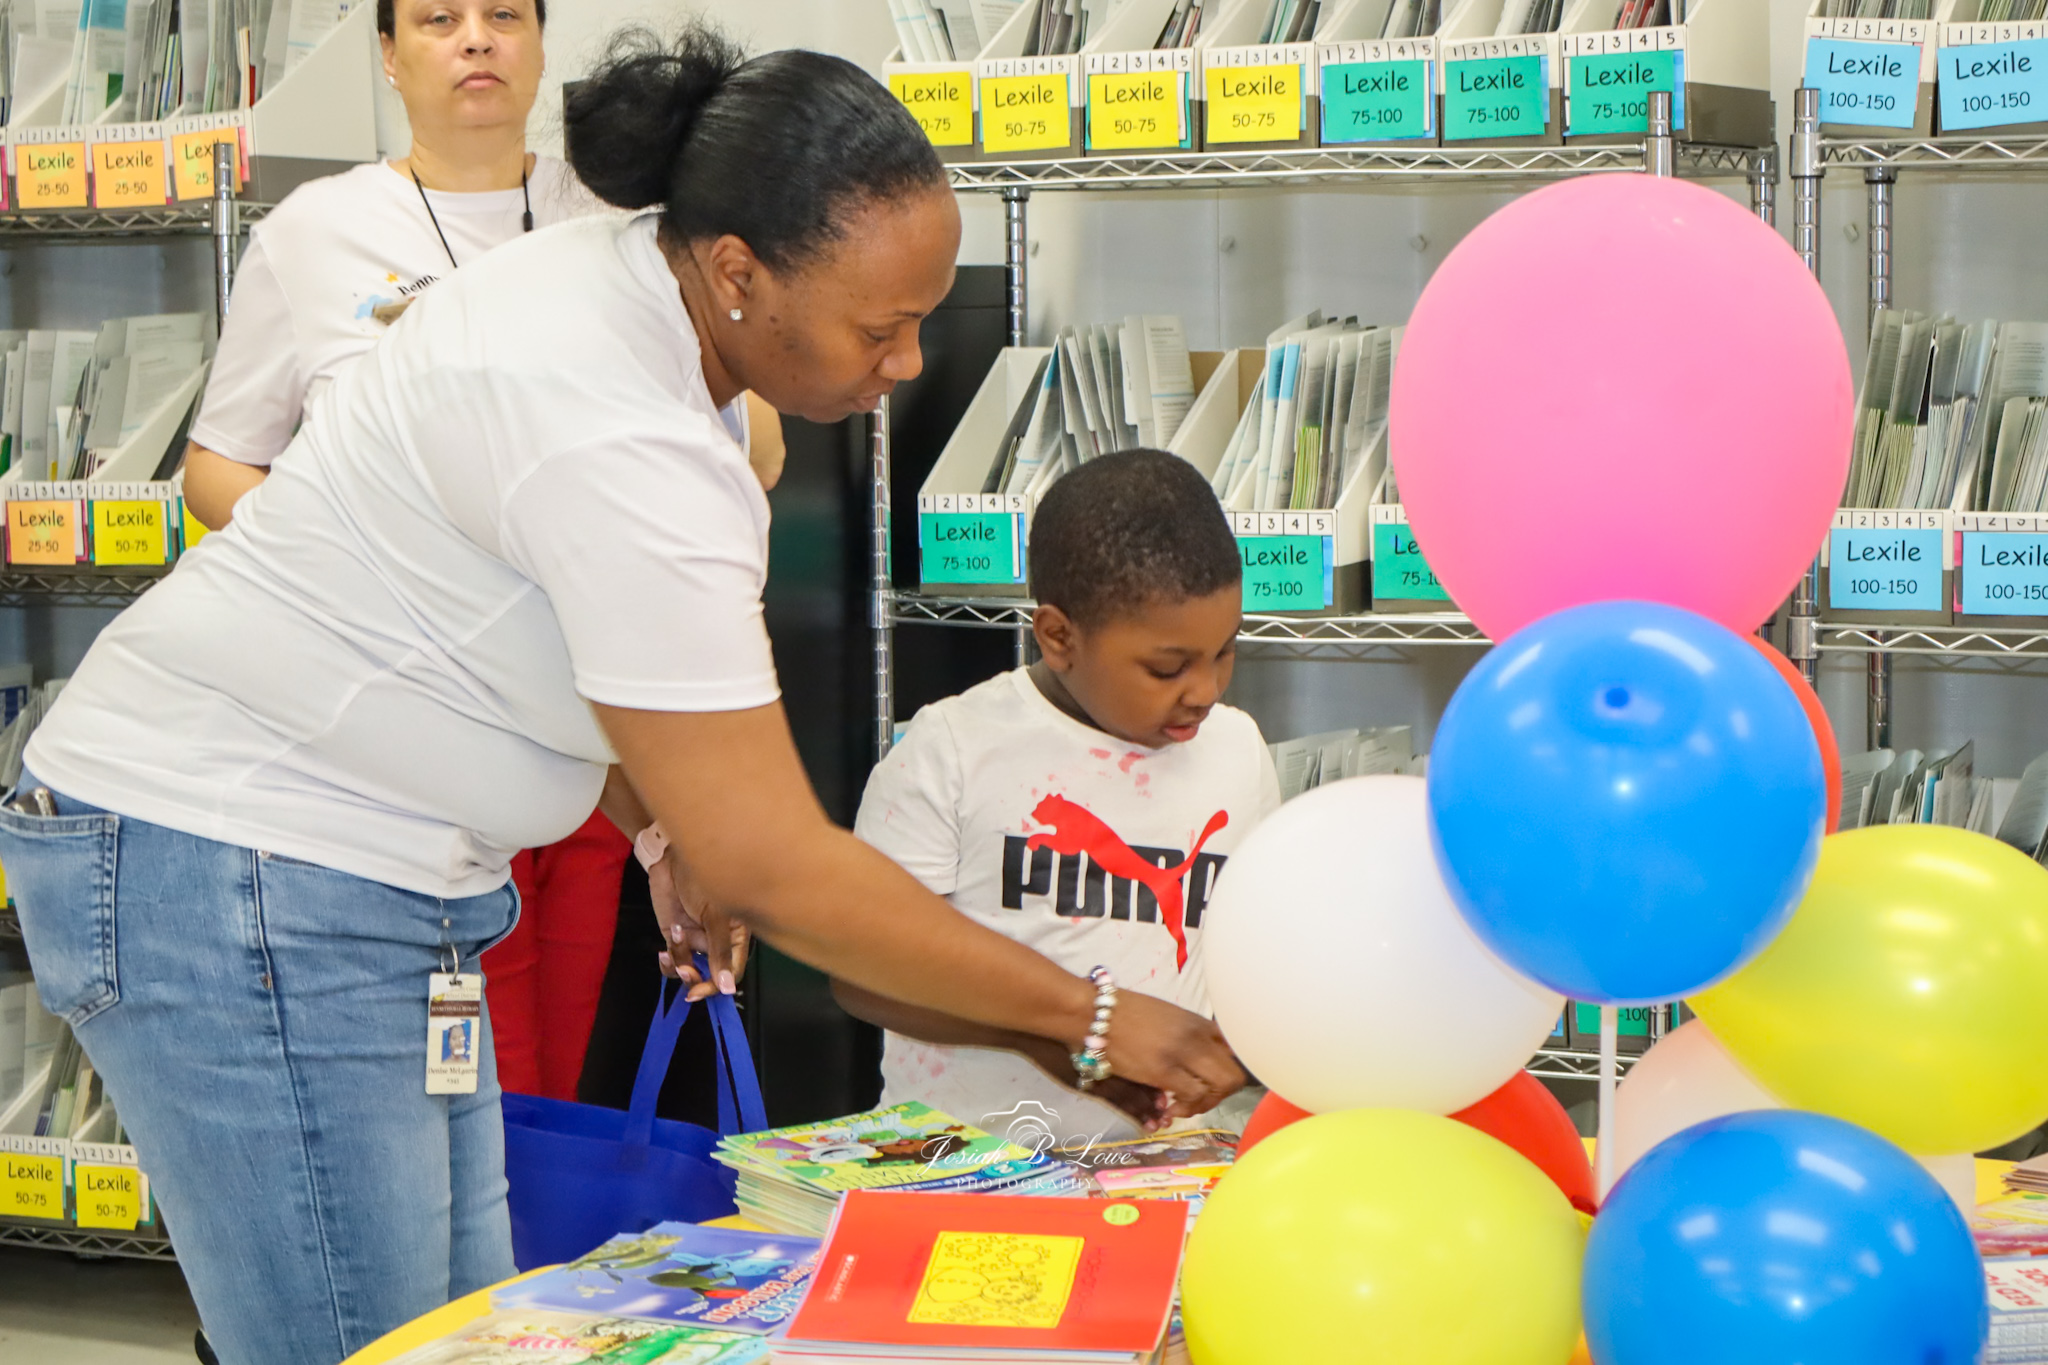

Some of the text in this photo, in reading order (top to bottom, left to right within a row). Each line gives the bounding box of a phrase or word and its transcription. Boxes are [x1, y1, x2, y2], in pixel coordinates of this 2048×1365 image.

[1842, 23, 1848, 33] 2
[1864, 25, 1871, 35] 3
[1887, 26, 1893, 35] 4
[1910, 27, 1917, 37] 5
[1981, 30, 1987, 40] 2
[2003, 29, 2010, 39] 3
[2027, 28, 2034, 38] 4
[1472, 46, 1478, 57] 2
[1492, 44, 1499, 55] 3
[1512, 43, 1519, 53] 4
[1533, 41, 1540, 51] 5
[1587, 38, 1594, 50] 2
[1613, 36, 1621, 48] 3
[1639, 35, 1648, 47] 4
[1666, 32, 1675, 45] 5
[1234, 53, 1241, 64] 2
[1253, 53, 1260, 63] 3
[1272, 52, 1279, 61] 4
[1292, 51, 1299, 61] 5
[1348, 47, 1356, 61] 2
[1372, 45, 1380, 58] 3
[1398, 44, 1406, 57] 4
[1422, 43, 1431, 56] 5
[1002, 63, 1009, 73] 2
[1020, 63, 1026, 73] 3
[1039, 63, 1045, 71] 4
[1057, 61, 1064, 71] 5
[1112, 57, 1119, 68] 2
[1134, 57, 1142, 68] 3
[1157, 55, 1165, 67] 4
[1180, 55, 1188, 67] 5
[1829, 52, 1901, 77] Lexile
[1956, 51, 2031, 79] Lexile
[1345, 70, 1408, 94] Lexile
[1461, 67, 1524, 92] Lexile
[1584, 64, 1655, 88] Lexile
[903, 81, 959, 103] Lexile
[1105, 81, 1164, 104] Lexile
[1223, 75, 1285, 97] Lexile
[995, 84, 1053, 107] Lexile
[1830, 92, 1895, 110] 100-150
[1963, 92, 2030, 112] 100-150
[1352, 108, 1402, 125] 75-100
[1468, 106, 1519, 123] 75-100
[1592, 102, 1647, 120] 75-100
[920, 118, 951, 131] 0-75
[1115, 119, 1155, 133] 50-75
[1233, 113, 1275, 127] 50-75
[1006, 121, 1046, 137] 50-75
[185, 139, 220, 159] Lex
[29, 152, 74, 171] Lexile
[106, 150, 153, 169] Lexile
[196, 174, 214, 184] 25-
[37, 183, 69, 195] 25-50
[116, 182, 147, 194] 25-50
[944, 498, 949, 508] 2
[966, 498, 973, 508] 3
[989, 498, 996, 508] 4
[1013, 497, 1020, 508] 5
[20, 510, 64, 527] Lexile
[107, 509, 153, 526] Lexile
[1244, 518, 1324, 530] 2 3 4 5
[1860, 516, 1866, 526] 2
[1883, 516, 1889, 526] 3
[1905, 517, 1912, 526] 4
[1928, 517, 1935, 527] 5
[936, 522, 995, 541] Lexile
[29, 541, 59, 552] 25-50
[116, 540, 148, 552] 50-75
[1848, 540, 1921, 561] Lexile
[942, 557, 990, 570] 75-100
[1245, 545, 1308, 566] Lexile
[1402, 571, 1441, 585] 75-1
[1253, 581, 1302, 596] 75-100
[1852, 580, 1917, 594] 100-150
[1002, 836, 1228, 928] PUMA
[1619, 1008, 1647, 1022] -100
[9, 1162, 52, 1181] Lexile
[88, 1174, 131, 1192] Lexile
[16, 1192, 46, 1206] 50-75
[96, 1204, 127, 1217] 50-75
